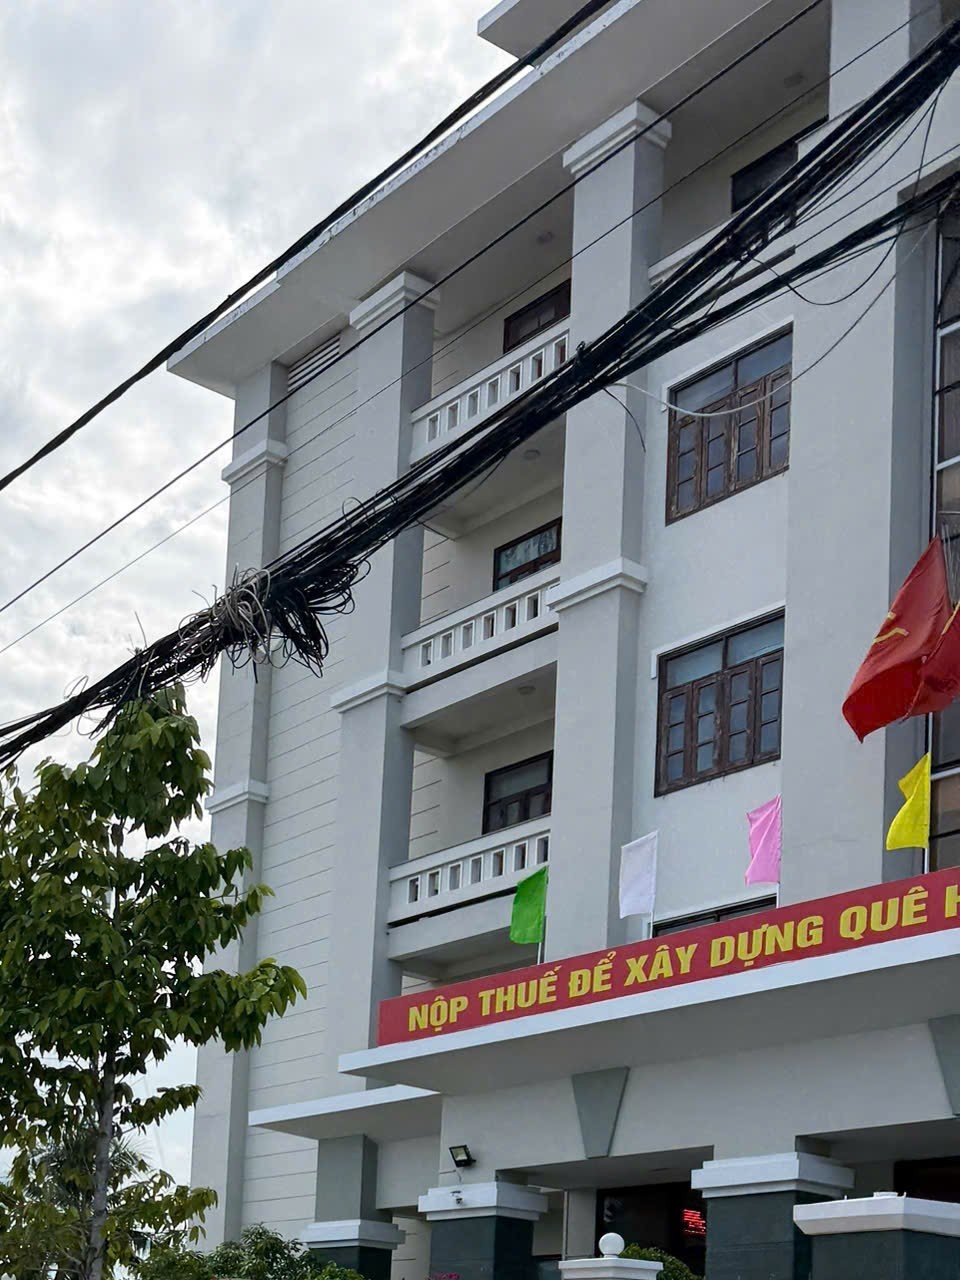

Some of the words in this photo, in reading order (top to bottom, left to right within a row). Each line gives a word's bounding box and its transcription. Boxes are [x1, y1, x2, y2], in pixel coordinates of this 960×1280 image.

[408, 995, 468, 1032] NỘP
[478, 965, 562, 1016] THUẾ
[568, 951, 616, 998] ĐỂ
[624, 944, 697, 987] XÂY
[710, 915, 823, 967] DỰNG
[840, 886, 928, 940] QUÊ
